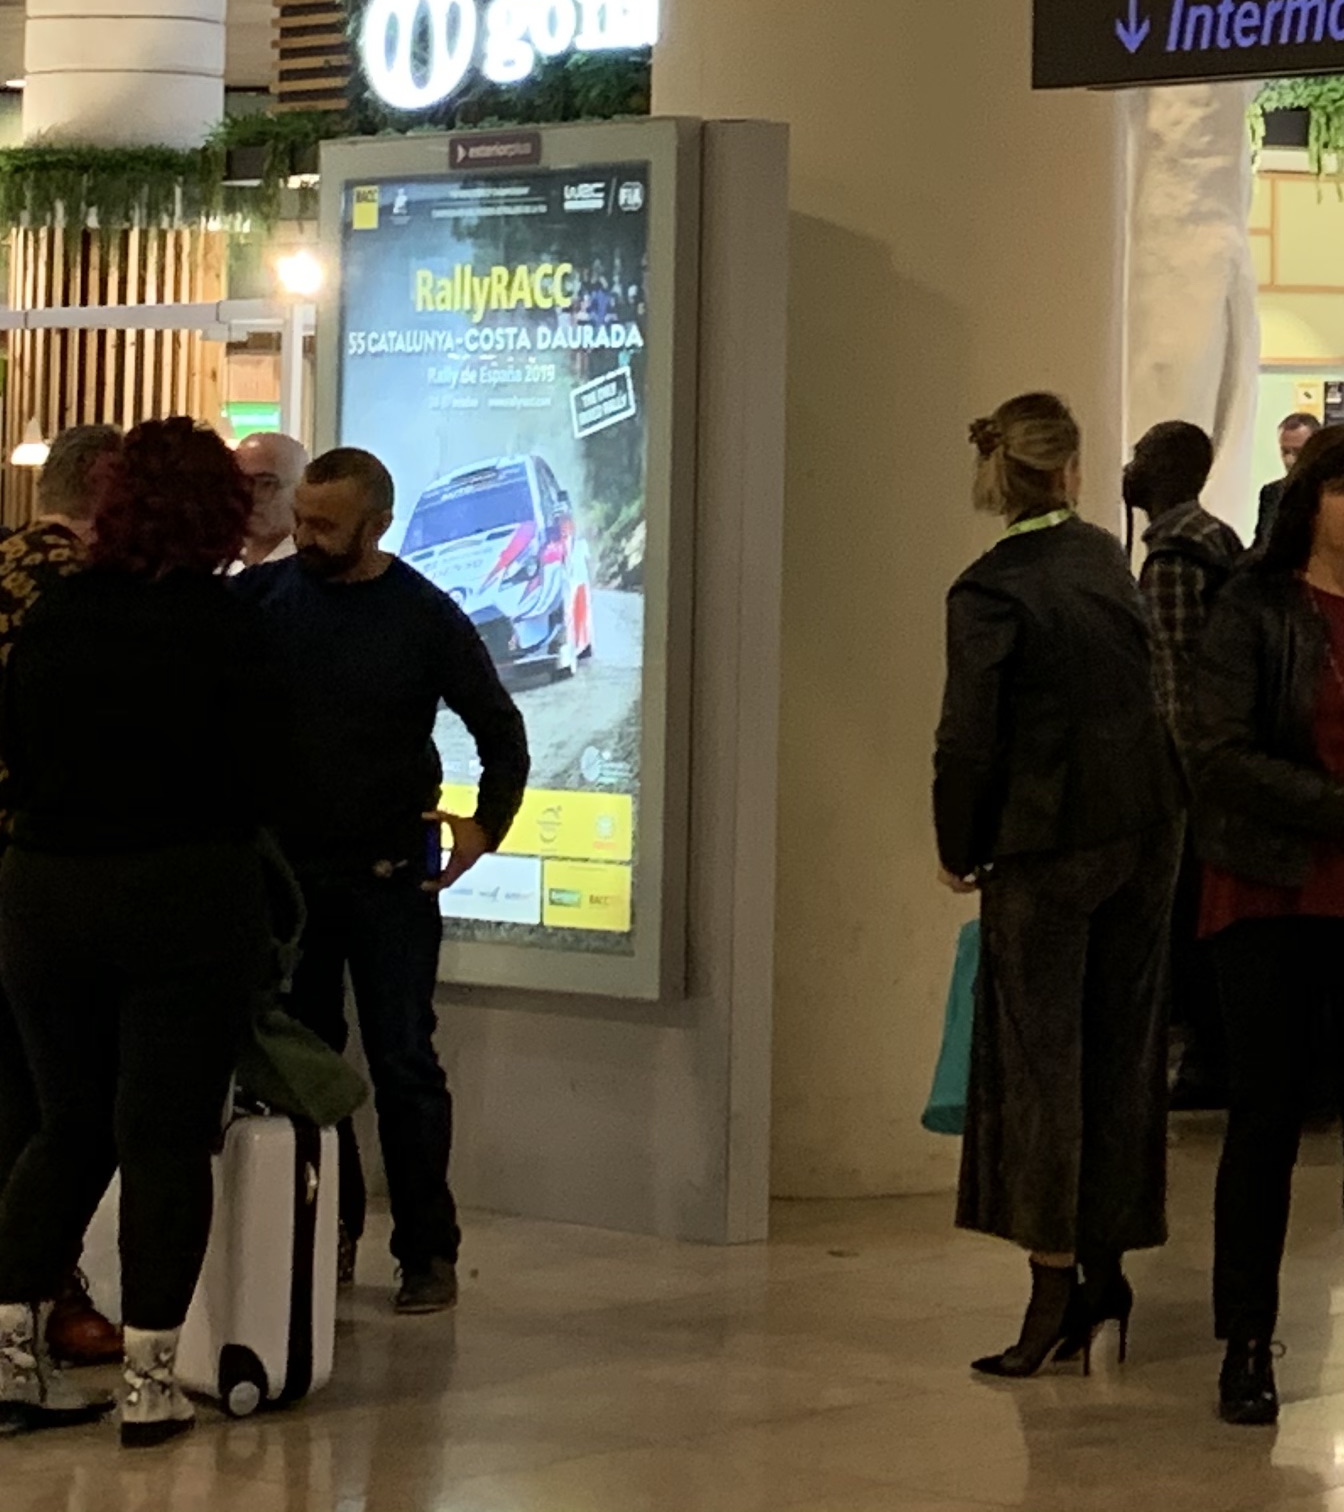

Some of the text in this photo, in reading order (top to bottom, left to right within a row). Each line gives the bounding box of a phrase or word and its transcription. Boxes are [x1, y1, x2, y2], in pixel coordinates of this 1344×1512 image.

[416, 263, 574, 323] RallyRACC
[349, 324, 644, 355] 55 CATALUNYA-COSTA DAURADA
[427, 366, 459, 389] Rally
[460, 365, 477, 384] de
[524, 364, 556, 383] 2019
